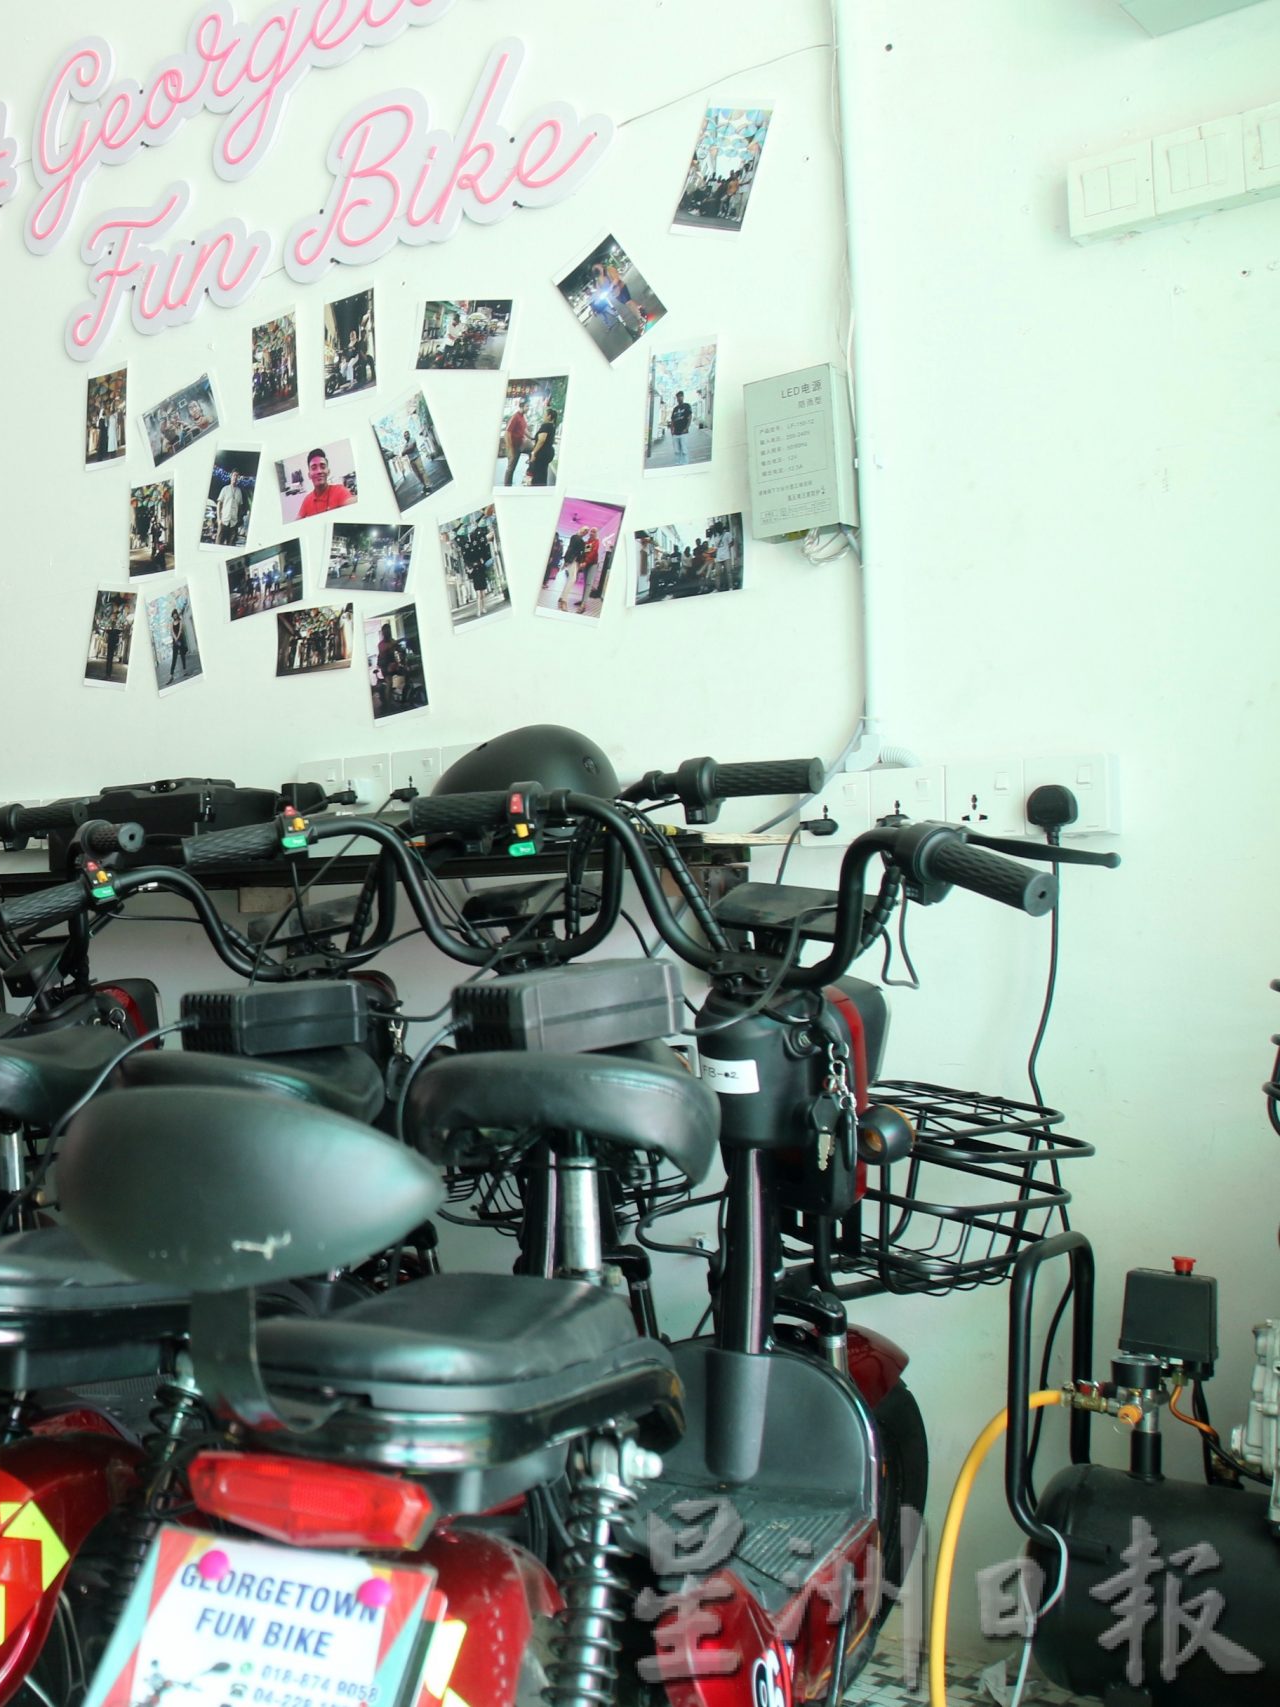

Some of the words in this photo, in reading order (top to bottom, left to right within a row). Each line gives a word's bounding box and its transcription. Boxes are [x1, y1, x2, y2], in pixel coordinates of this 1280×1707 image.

[72, 194, 260, 347] Fun
[294, 52, 598, 266] Bike
[194, 1606, 256, 1643] FUN
[263, 1619, 336, 1659] BIKE
[261, 1664, 332, 1693] 018-874
[336, 1679, 380, 1704] 9058
